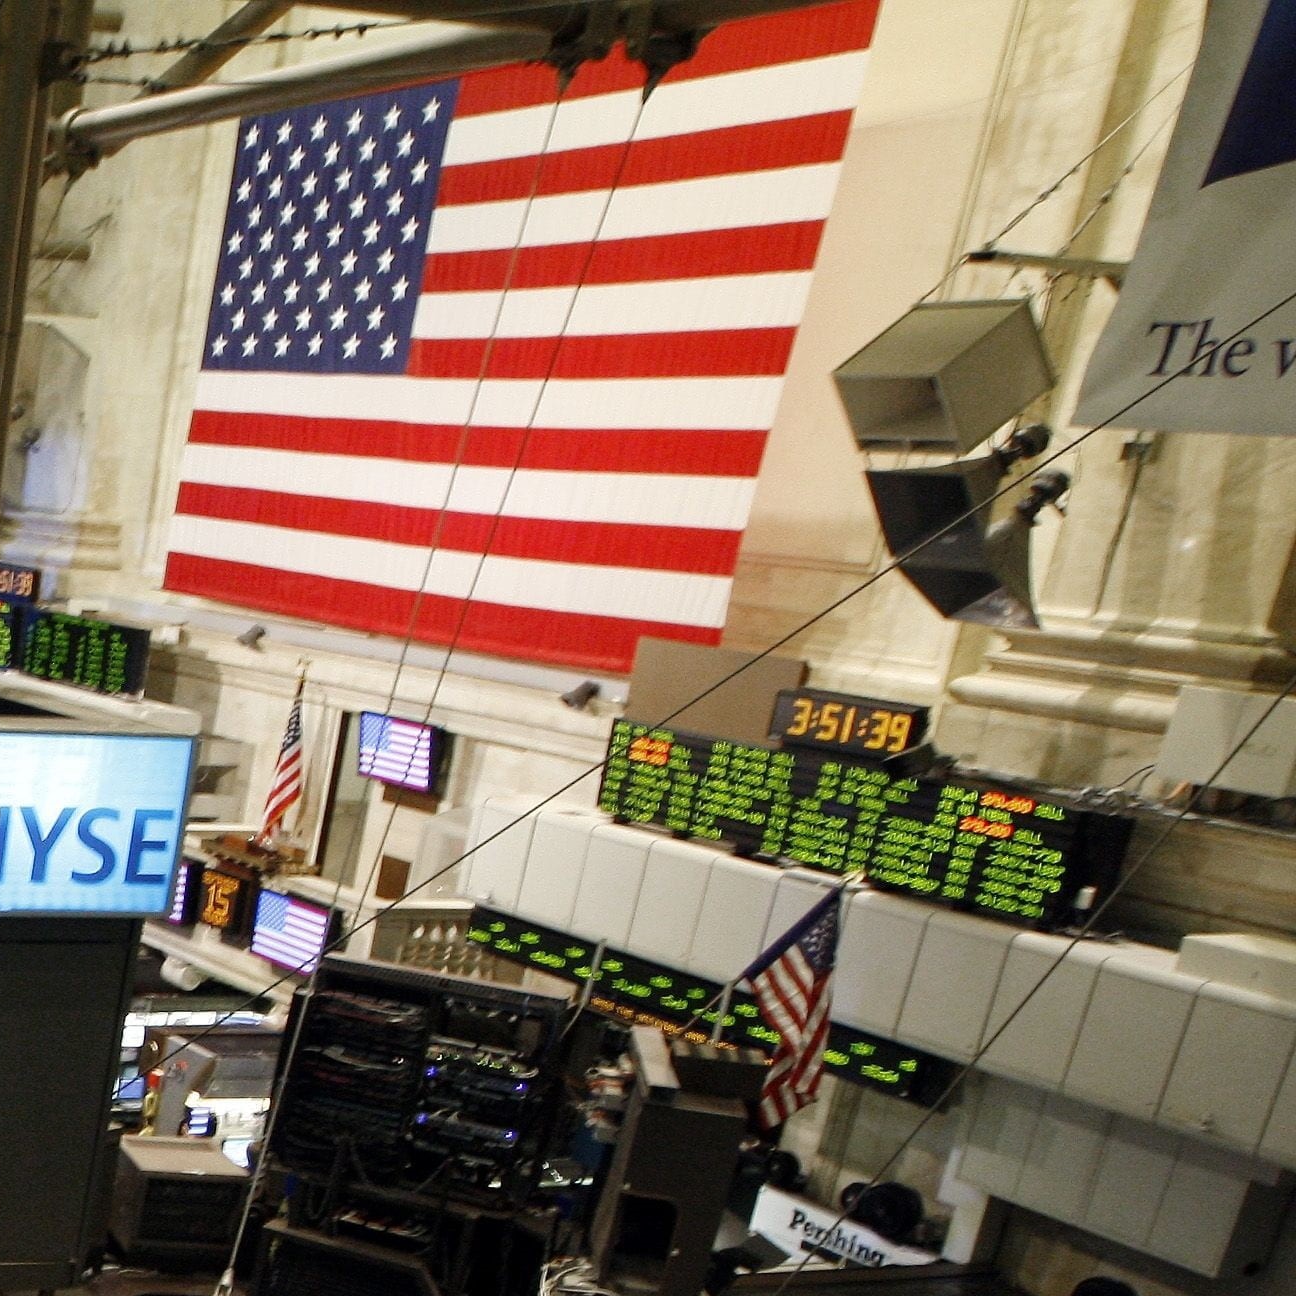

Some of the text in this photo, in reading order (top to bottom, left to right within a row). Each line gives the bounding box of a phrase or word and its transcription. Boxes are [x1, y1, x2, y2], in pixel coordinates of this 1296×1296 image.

[1144, 316, 1256, 378] The
[787, 698, 913, 752] 3:51:39
[788, 1207, 885, 1267] Perhing
